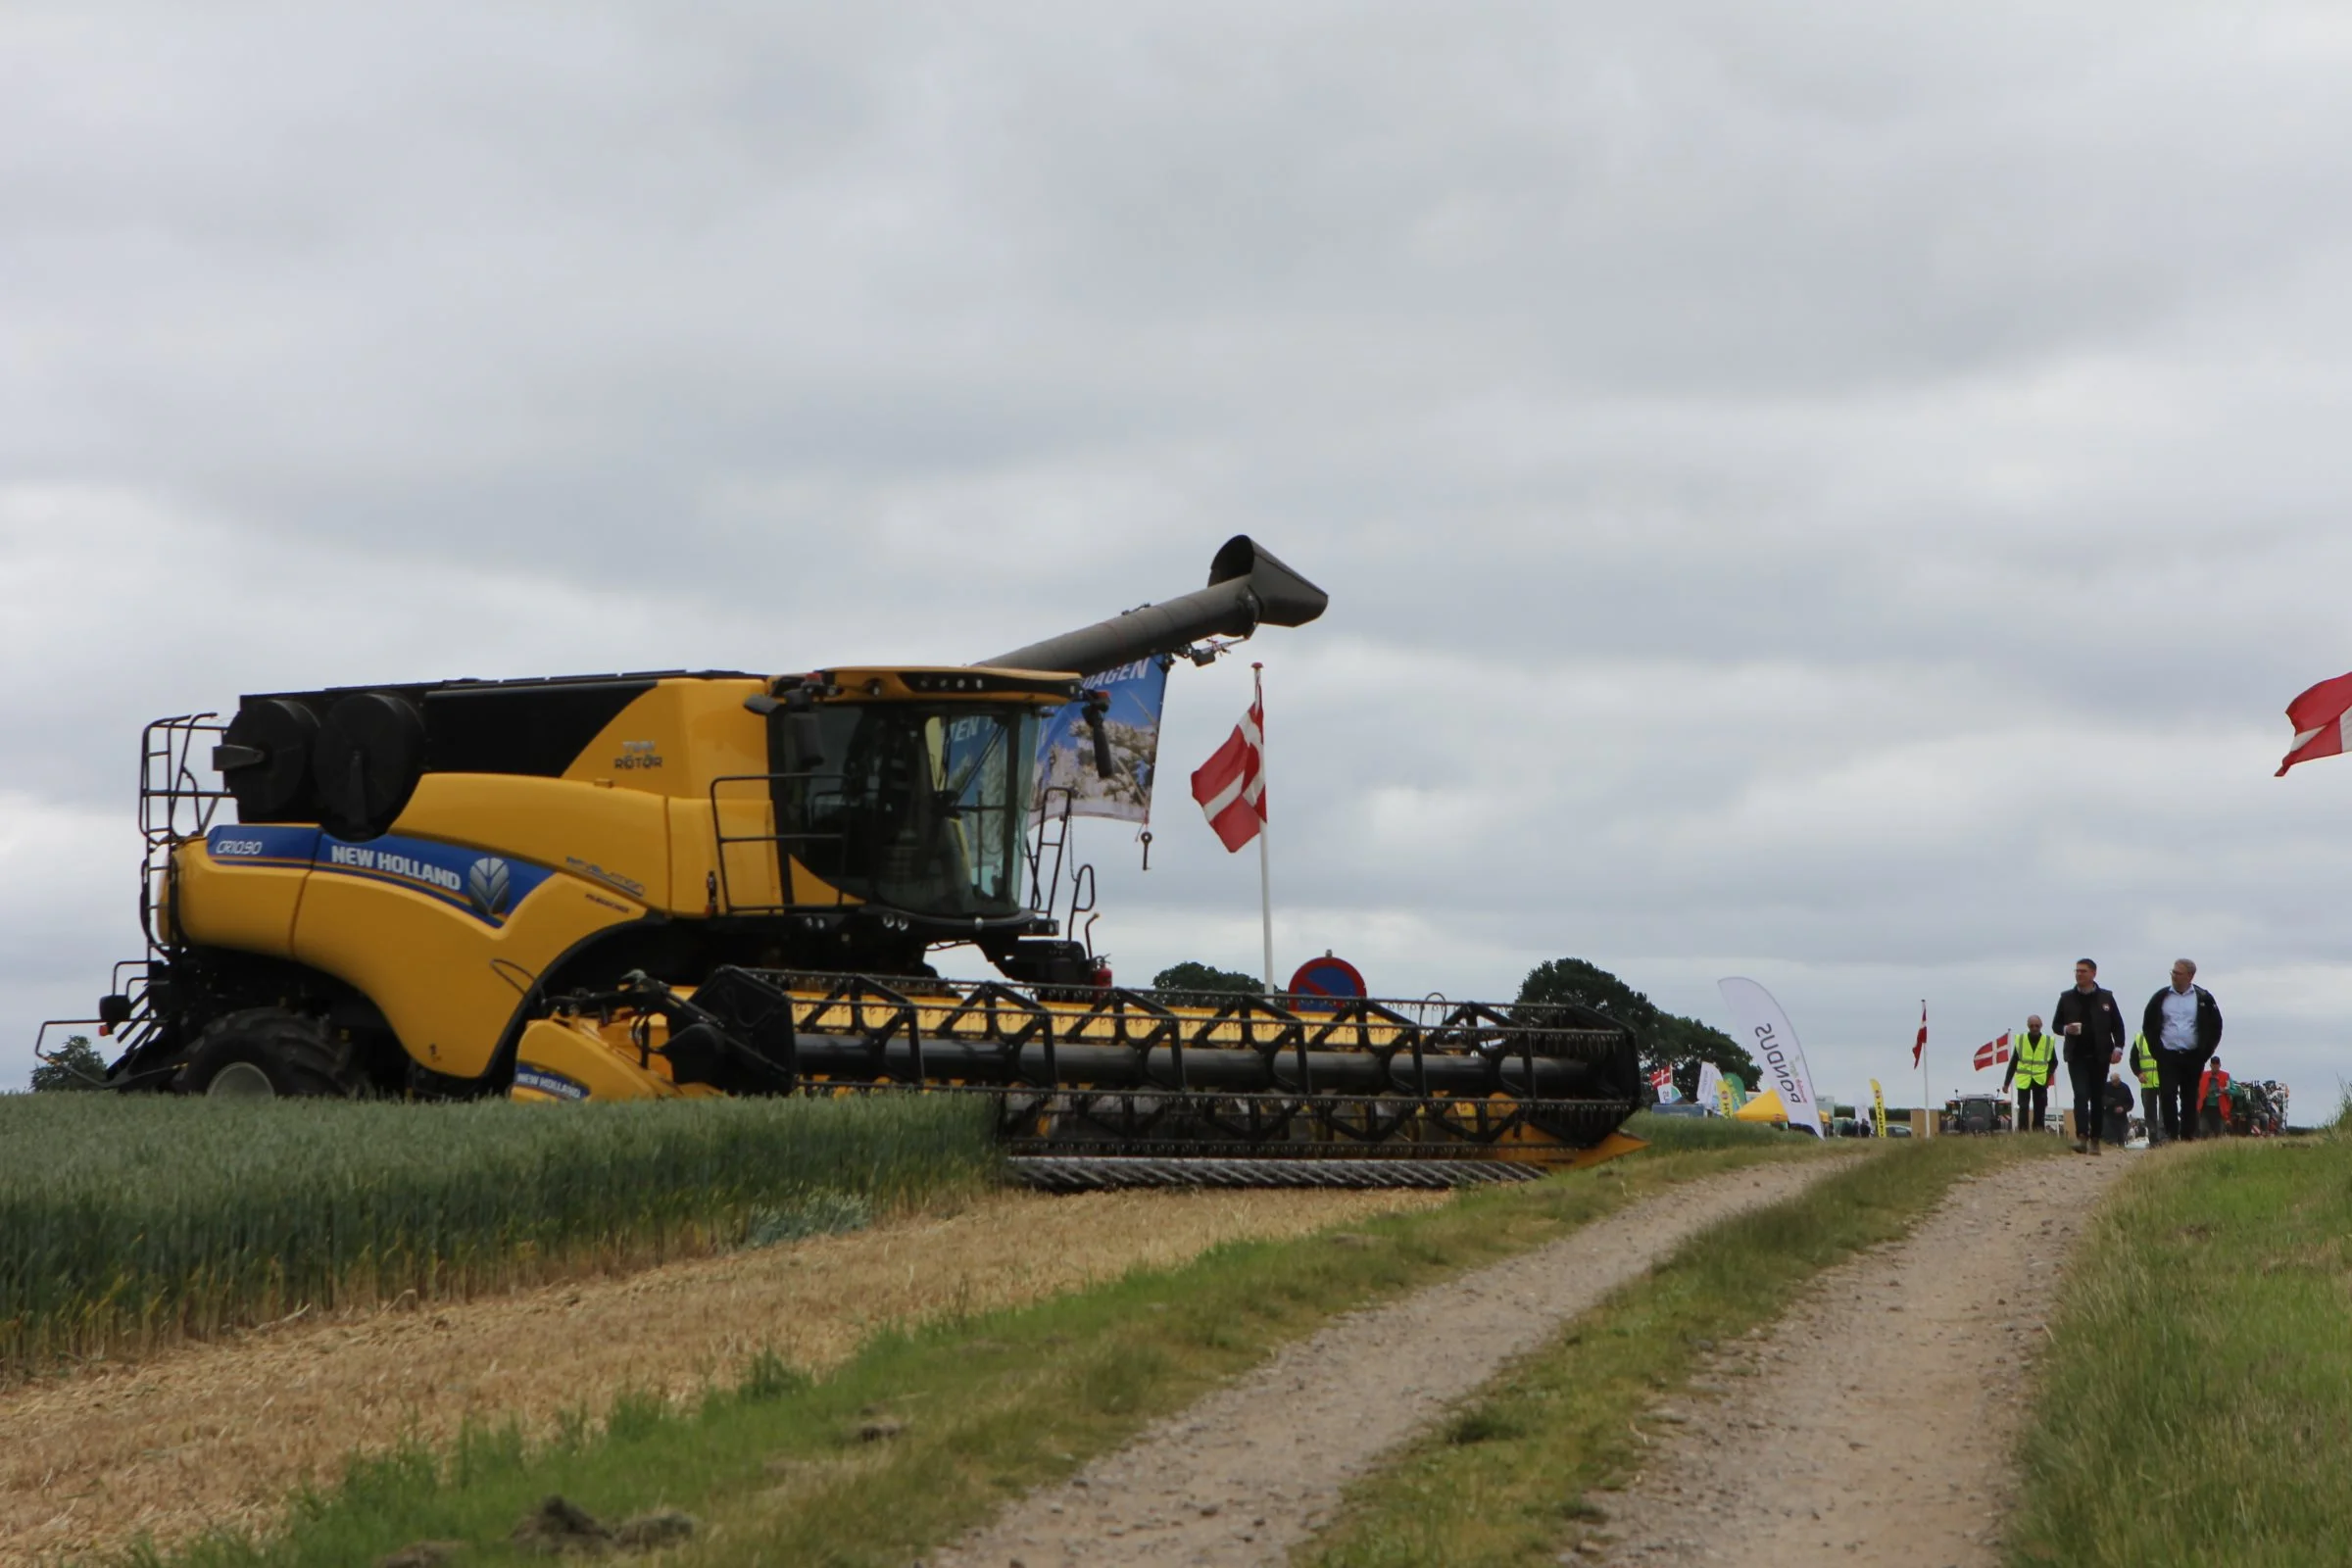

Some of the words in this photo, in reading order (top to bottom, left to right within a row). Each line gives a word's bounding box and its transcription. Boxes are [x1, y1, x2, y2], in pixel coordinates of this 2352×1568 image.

[613, 755, 663, 769] ROTOR
[330, 844, 375, 866] NEW
[377, 851, 461, 892] HOLLAND
[516, 1073, 539, 1086] NEW
[540, 1076, 581, 1099] HOLLAND
